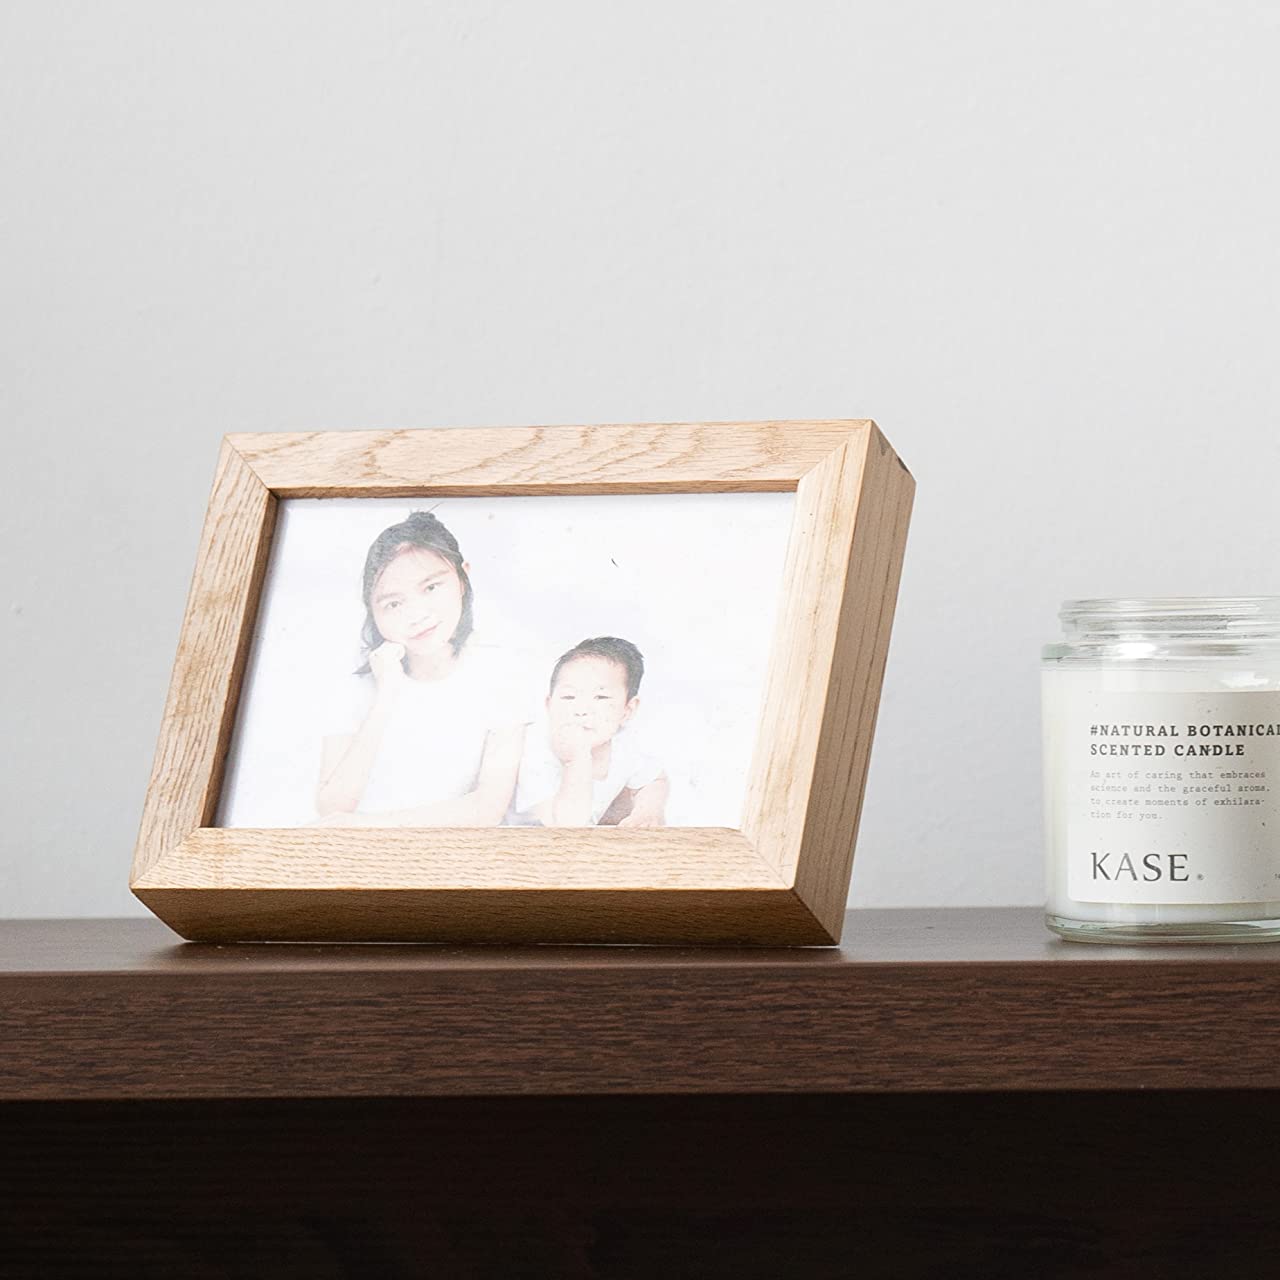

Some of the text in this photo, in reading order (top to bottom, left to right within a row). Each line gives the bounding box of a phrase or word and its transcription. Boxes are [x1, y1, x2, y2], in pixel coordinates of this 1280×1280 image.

[1090, 724, 1180, 737] #NATURAL
[1091, 743, 1246, 757] SCENTED CANDLE
[1127, 770, 1140, 779] of
[1145, 770, 1182, 780] caring
[1189, 770, 1213, 779] that
[1220, 769, 1266, 779] embraces
[1133, 783, 1151, 793] and
[1158, 783, 1176, 793] the
[1183, 783, 1231, 794] graceful
[1195, 797, 1208, 806] of
[1214, 797, 1265, 806] exhilara-
[1115, 810, 1133, 819] for
